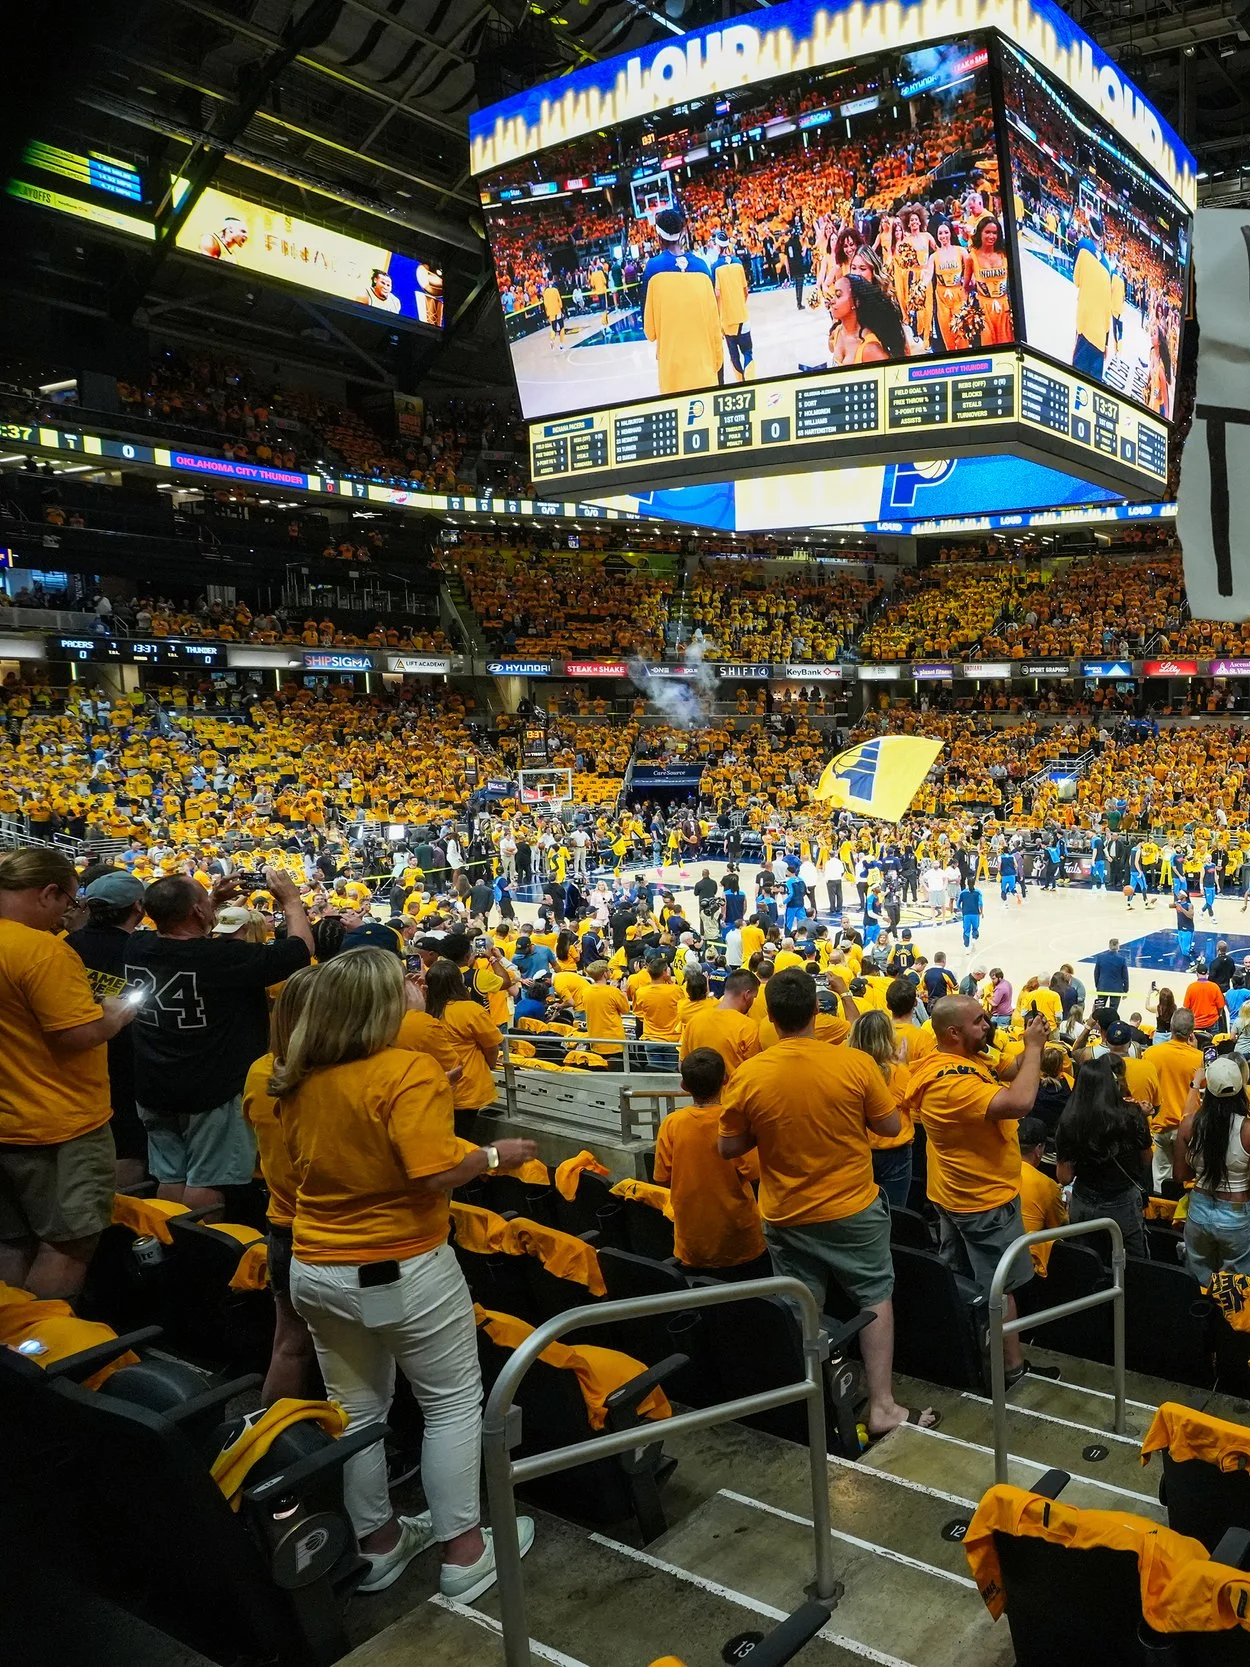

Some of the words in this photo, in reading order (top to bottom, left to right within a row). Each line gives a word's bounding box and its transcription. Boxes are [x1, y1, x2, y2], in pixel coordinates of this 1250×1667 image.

[628, 23, 760, 92] LOUD
[1081, 38, 1163, 151] LOUD
[912, 367, 945, 378] OKLAHOMA
[945, 365, 959, 375] CITY
[960, 363, 989, 373] THUNDER
[962, 391, 983, 399] BLOCKS
[717, 393, 751, 413] 13:37
[962, 400, 982, 409] STEALS
[1094, 395, 1118, 420] 13:37
[723, 416, 734, 424] 1ST
[734, 414, 746, 423] QTR
[770, 422, 780, 439] 0
[1077, 421, 1085, 438] 0
[692, 434, 701, 449] 0
[122, 444, 135, 459] 0
[1125, 443, 1132, 459] 0
[176, 456, 234, 474] OKLAHOMA
[235, 466, 257, 477] CITY
[259, 470, 303, 485] THUNDER
[326, 483, 334, 493] 0
[541, 506, 556, 515] 0/0
[584, 508, 599, 517] 0/0
[1128, 506, 1152, 517] LOUD
[1000, 515, 1023, 526] LOUD
[877, 522, 903, 531] LOUD
[61, 639, 95, 649] PACERS
[133, 644, 158, 653] 13:37
[79, 650, 87, 659] 0
[185, 645, 218, 655] THUNDER
[205, 655, 212, 664] 0
[304, 654, 373, 668] SHIPSIGMA
[505, 664, 551, 672] HYUNDAI
[567, 665, 593, 673] STEAK
[598, 665, 625, 673] SHAKE
[719, 667, 757, 676] SHIFT
[786, 668, 822, 677] KeyBank
[919, 668, 935, 676] planet
[1159, 662, 1180, 675] Lilly
[526, 730, 544, 739] 13:37
[673, 959, 684, 971] 43
[900, 954, 908, 967] 0
[87, 970, 126, 989] AME
[124, 963, 207, 1029] 24
[1089, 1447, 1102, 1460] 11
[949, 1523, 967, 1539] 12
[731, 1640, 755, 1660] 13
